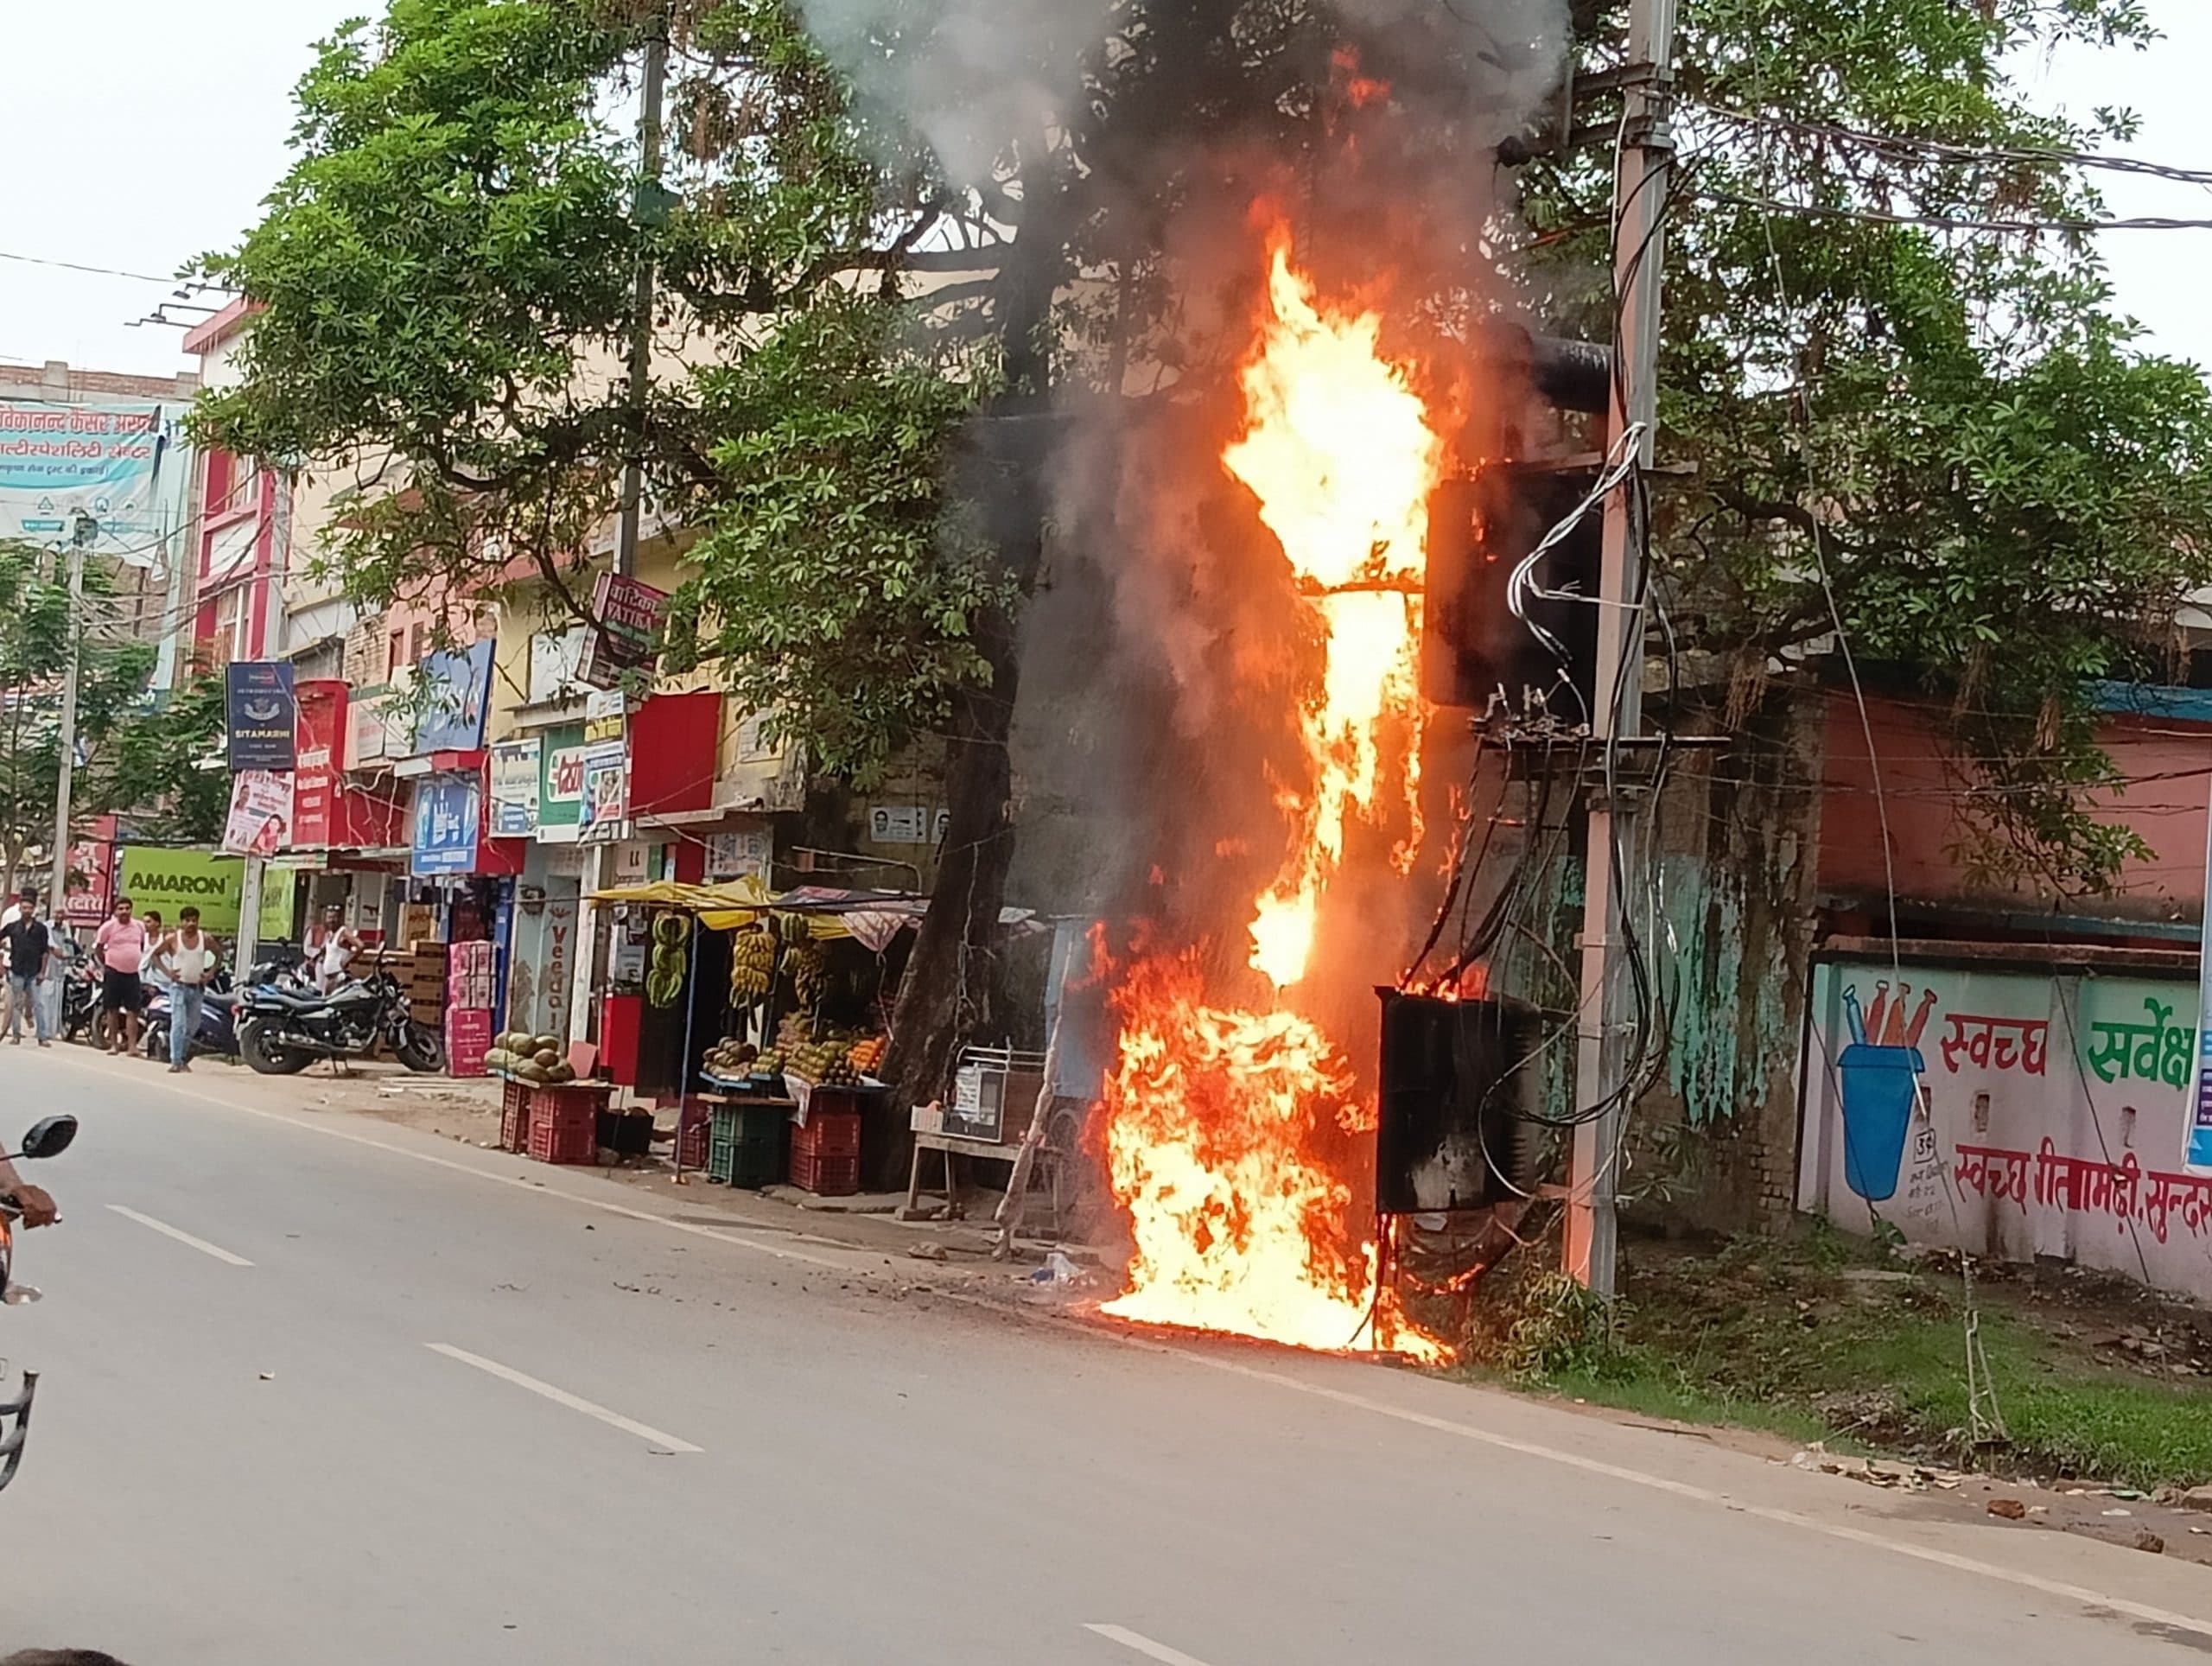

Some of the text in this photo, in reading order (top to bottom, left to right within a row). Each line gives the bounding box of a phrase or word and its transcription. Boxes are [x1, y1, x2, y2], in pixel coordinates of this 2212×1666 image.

[607, 601, 652, 633] VATIKA
[129, 872, 225, 894] AMARON
[2087, 997, 2196, 1092] सर्वेक्ष
